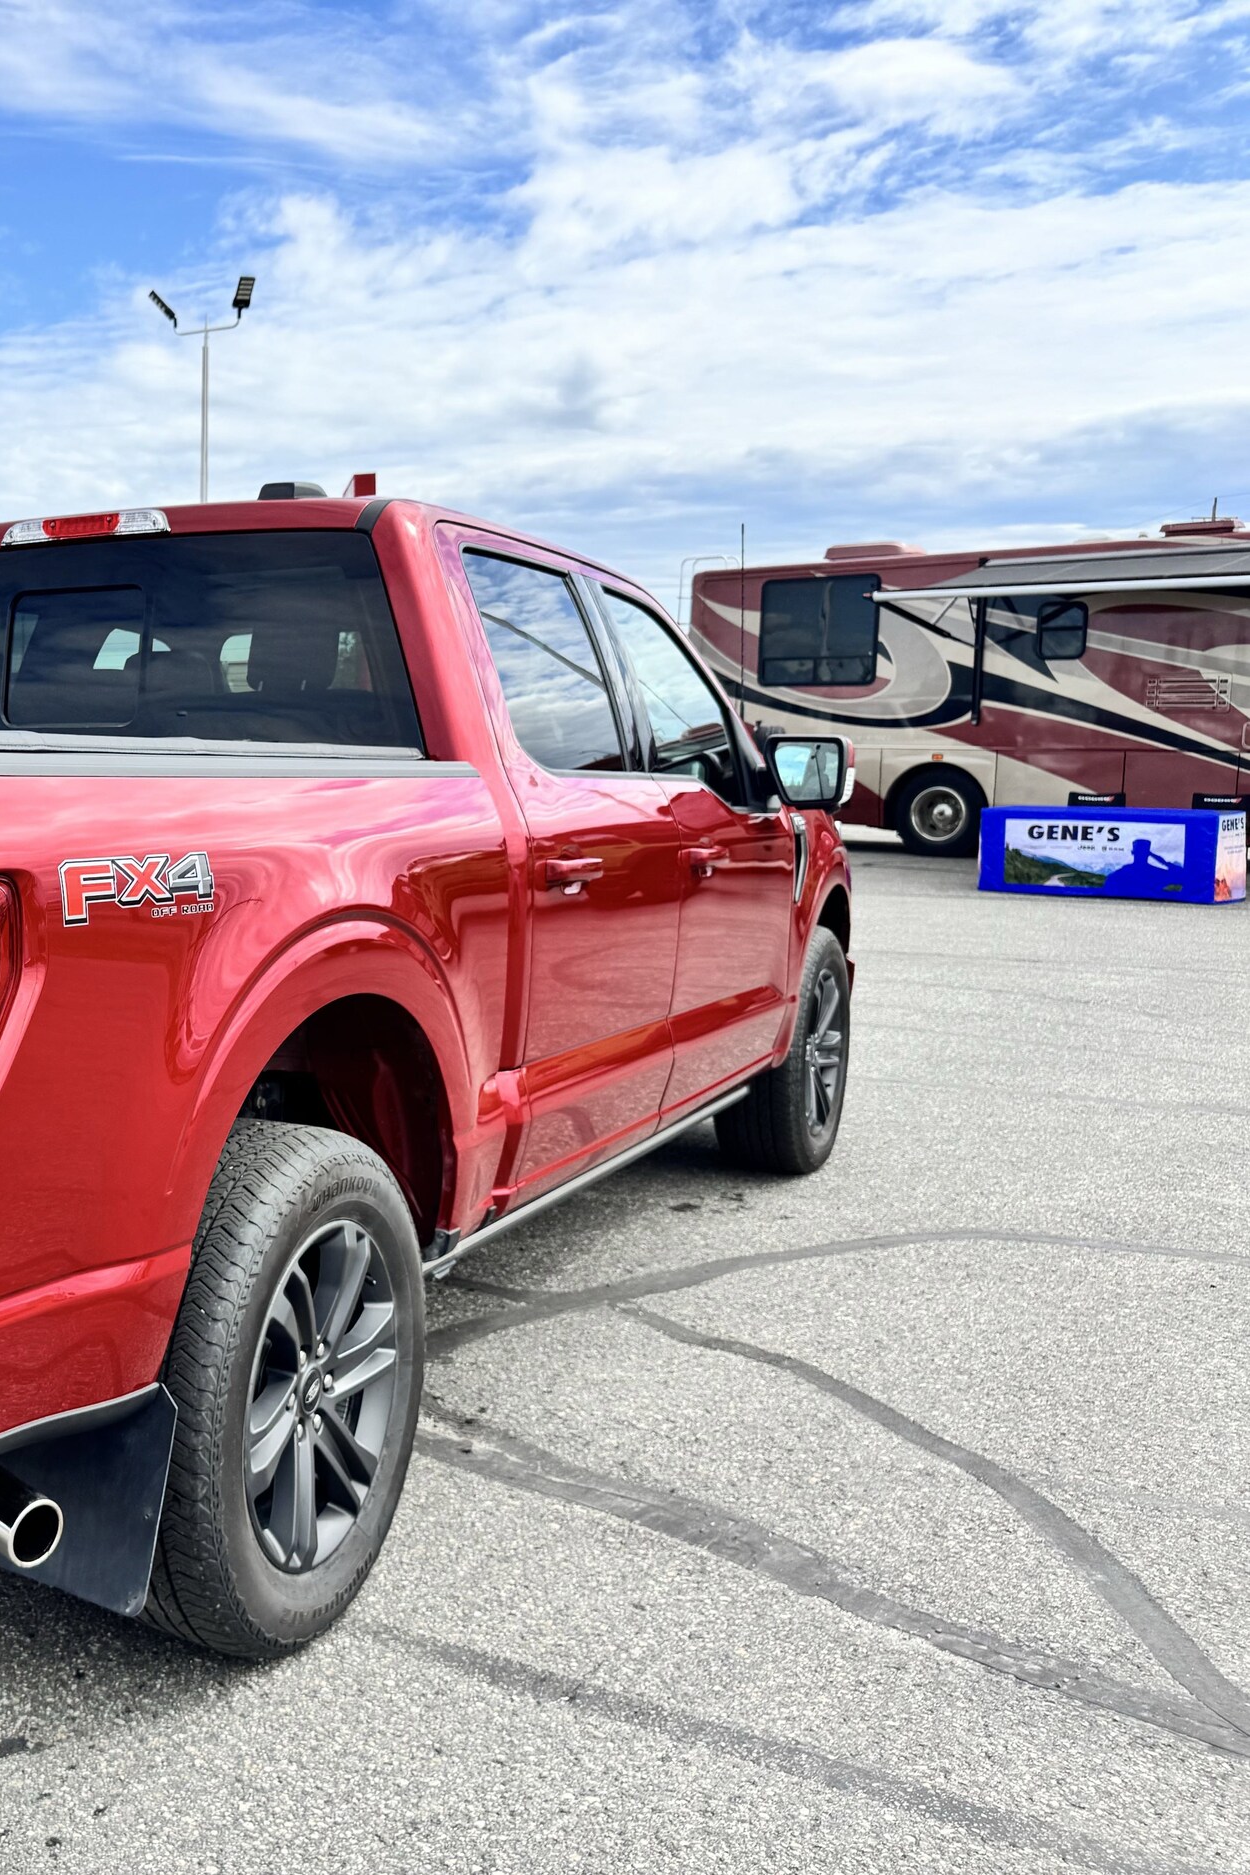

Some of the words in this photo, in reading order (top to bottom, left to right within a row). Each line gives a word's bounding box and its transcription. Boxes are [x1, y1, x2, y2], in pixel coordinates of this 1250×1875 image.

[1221, 817, 1244, 831] GENE'S
[1027, 824, 1120, 842] GENE'S
[57, 851, 215, 927] FX4
[151, 906, 177, 918] OFF
[181, 902, 215, 915] ROAD
